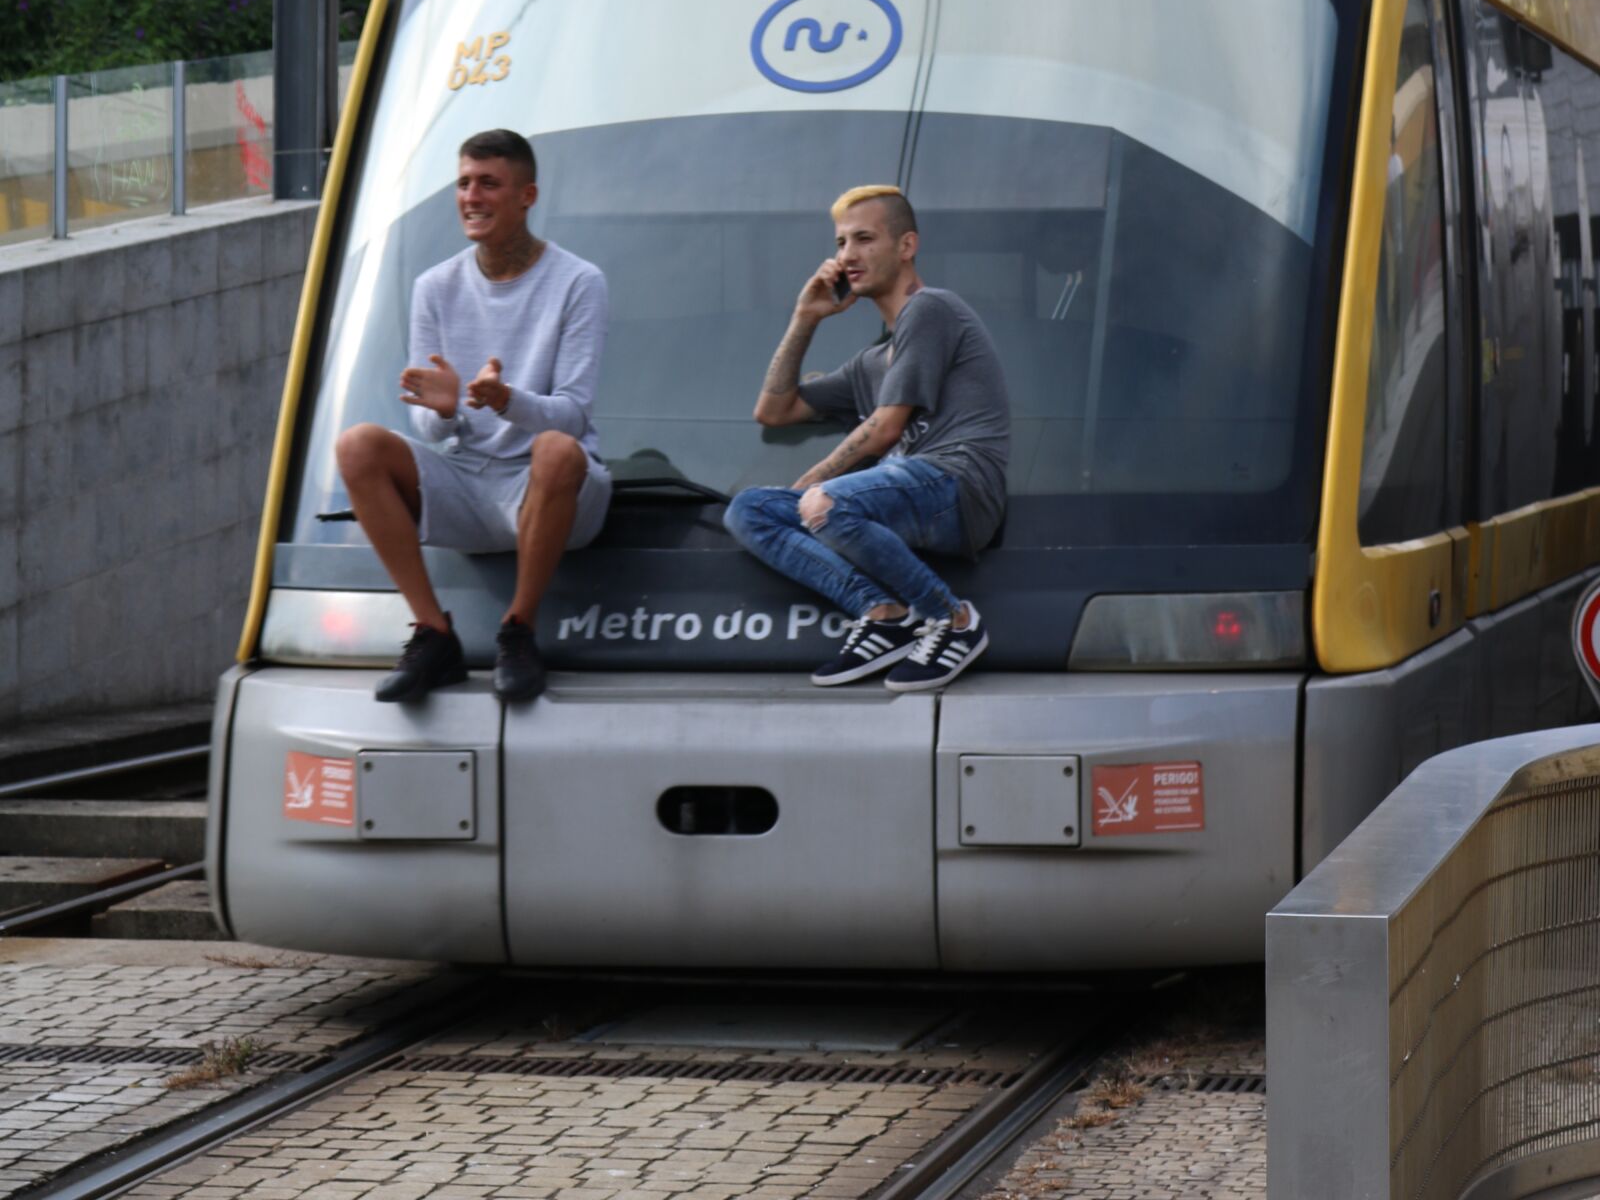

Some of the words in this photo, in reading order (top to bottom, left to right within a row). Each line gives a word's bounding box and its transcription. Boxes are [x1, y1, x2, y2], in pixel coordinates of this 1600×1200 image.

[453, 30, 511, 68] MP
[447, 53, 512, 91] 043
[557, 603, 702, 641] Metro
[712, 608, 774, 641] do
[787, 603, 847, 640] Po
[1153, 771, 1199, 786] PERIGO!
